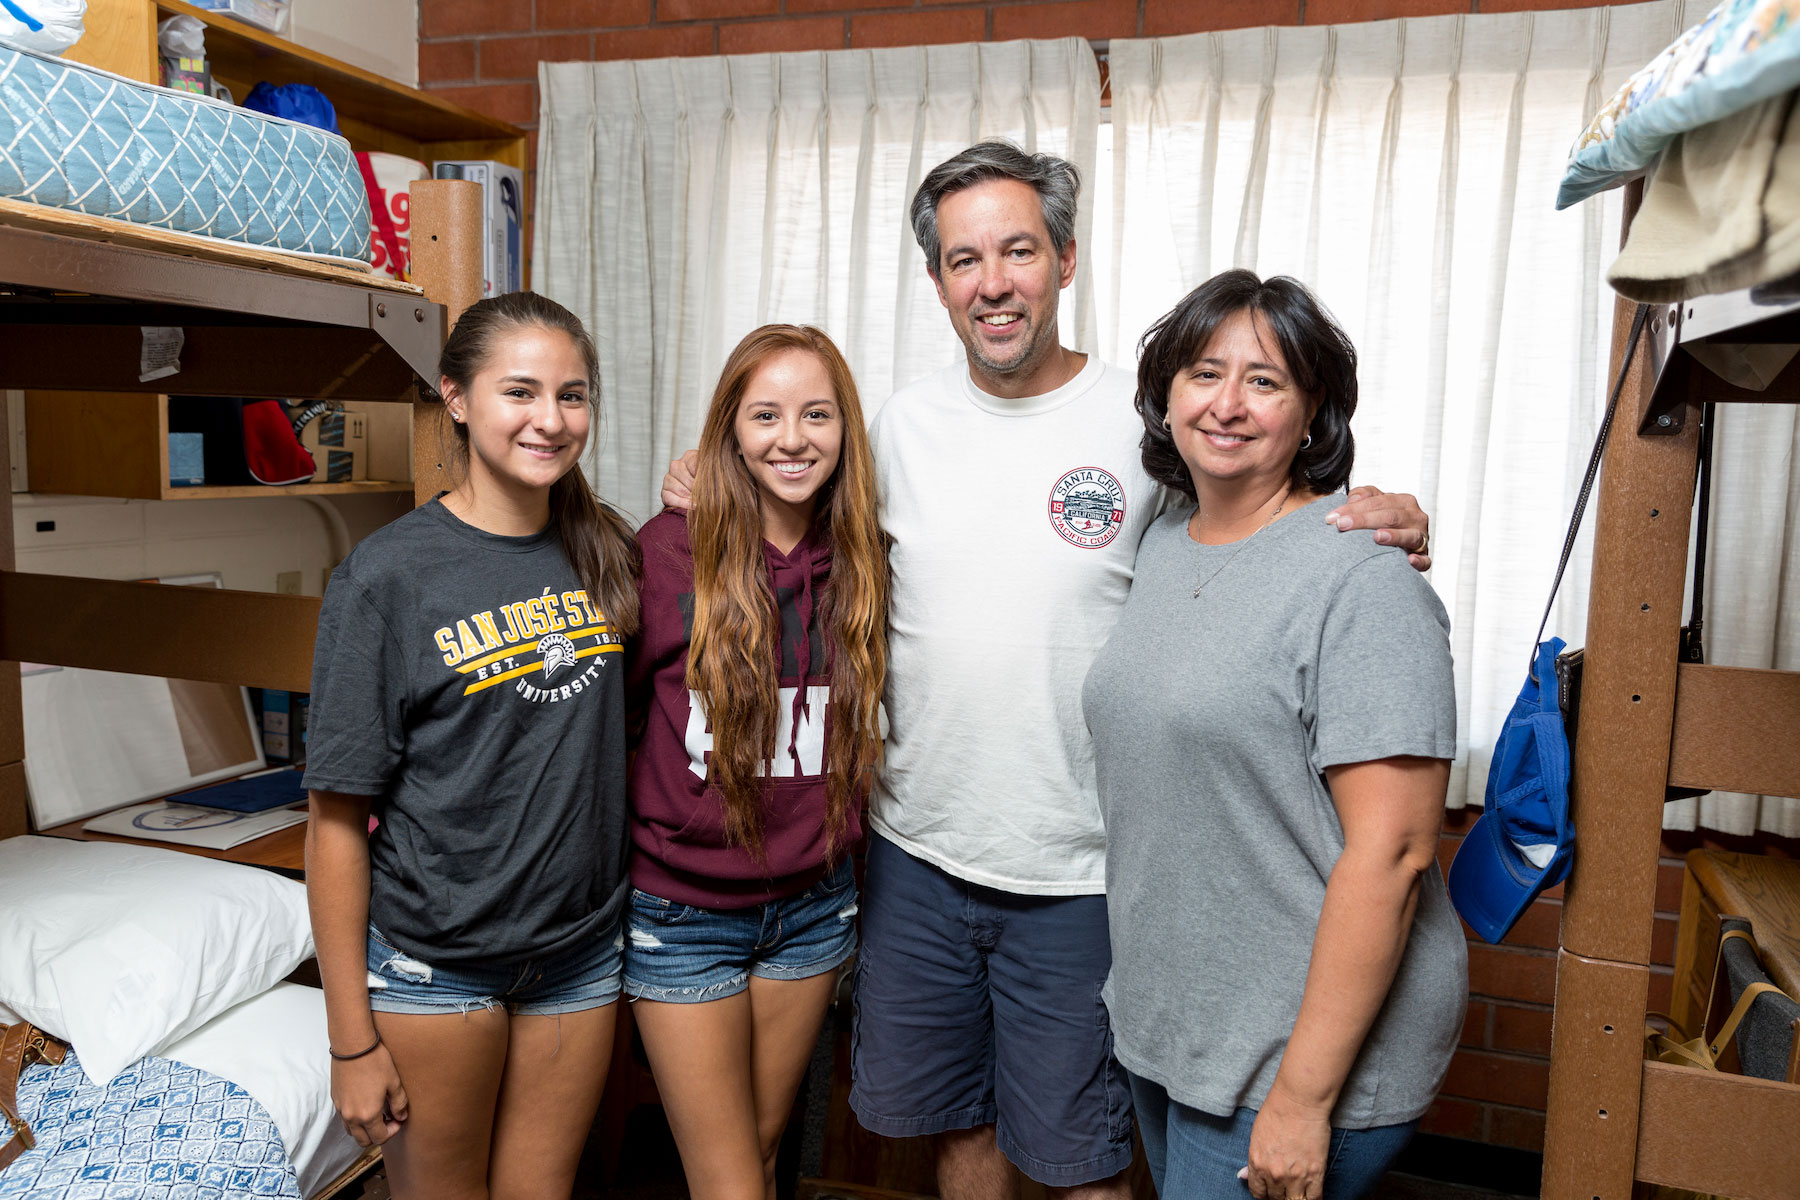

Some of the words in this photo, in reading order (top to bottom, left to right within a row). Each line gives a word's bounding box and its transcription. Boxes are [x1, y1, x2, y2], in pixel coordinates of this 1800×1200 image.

[1057, 471, 1093, 496] SANTA
[1097, 473, 1122, 503] CRUZ
[1053, 502, 1064, 512] 19
[1070, 510, 1106, 520] CALIFORNIA
[1112, 511, 1123, 521] 71
[1054, 516, 1088, 544] PACIFIC
[1090, 524, 1117, 545] COAST
[434, 611, 503, 667] SAN
[499, 587, 567, 643] JOSÉ
[476, 657, 520, 681] EST.
[515, 655, 606, 704] UNIVERSITY
